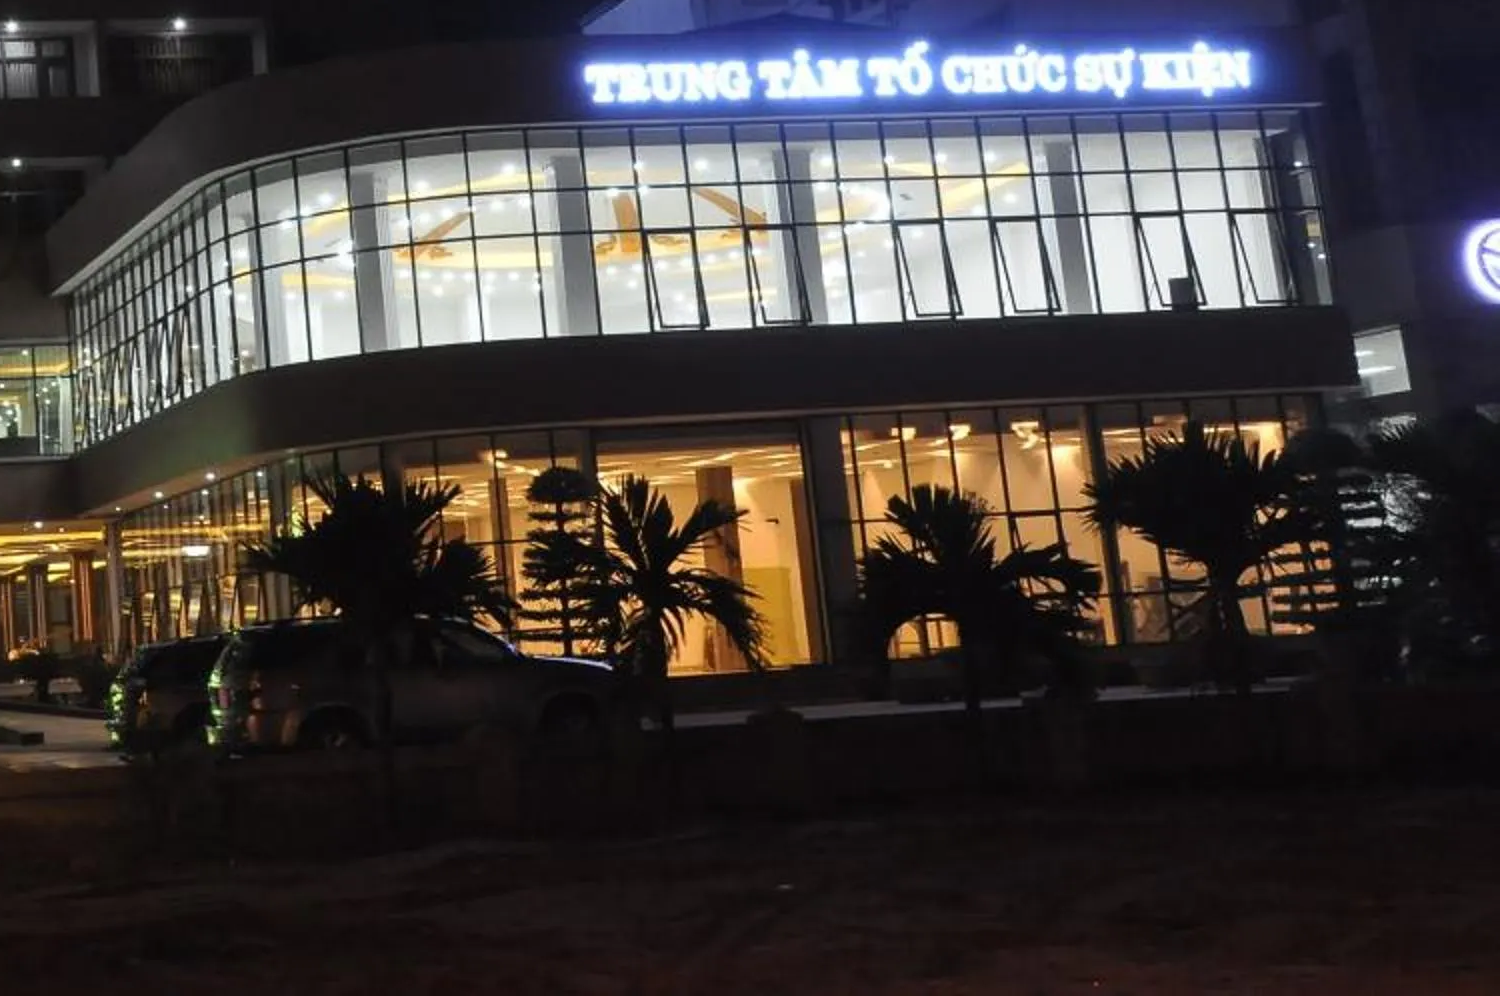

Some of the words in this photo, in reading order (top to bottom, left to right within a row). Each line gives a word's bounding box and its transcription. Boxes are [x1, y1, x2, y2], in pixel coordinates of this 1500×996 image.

[584, 60, 752, 104] TRUNG
[757, 48, 863, 99] TÂM
[941, 43, 1067, 94] CHỨC
[1073, 47, 1135, 99] SỰ
[1139, 41, 1251, 98] KIỆN
